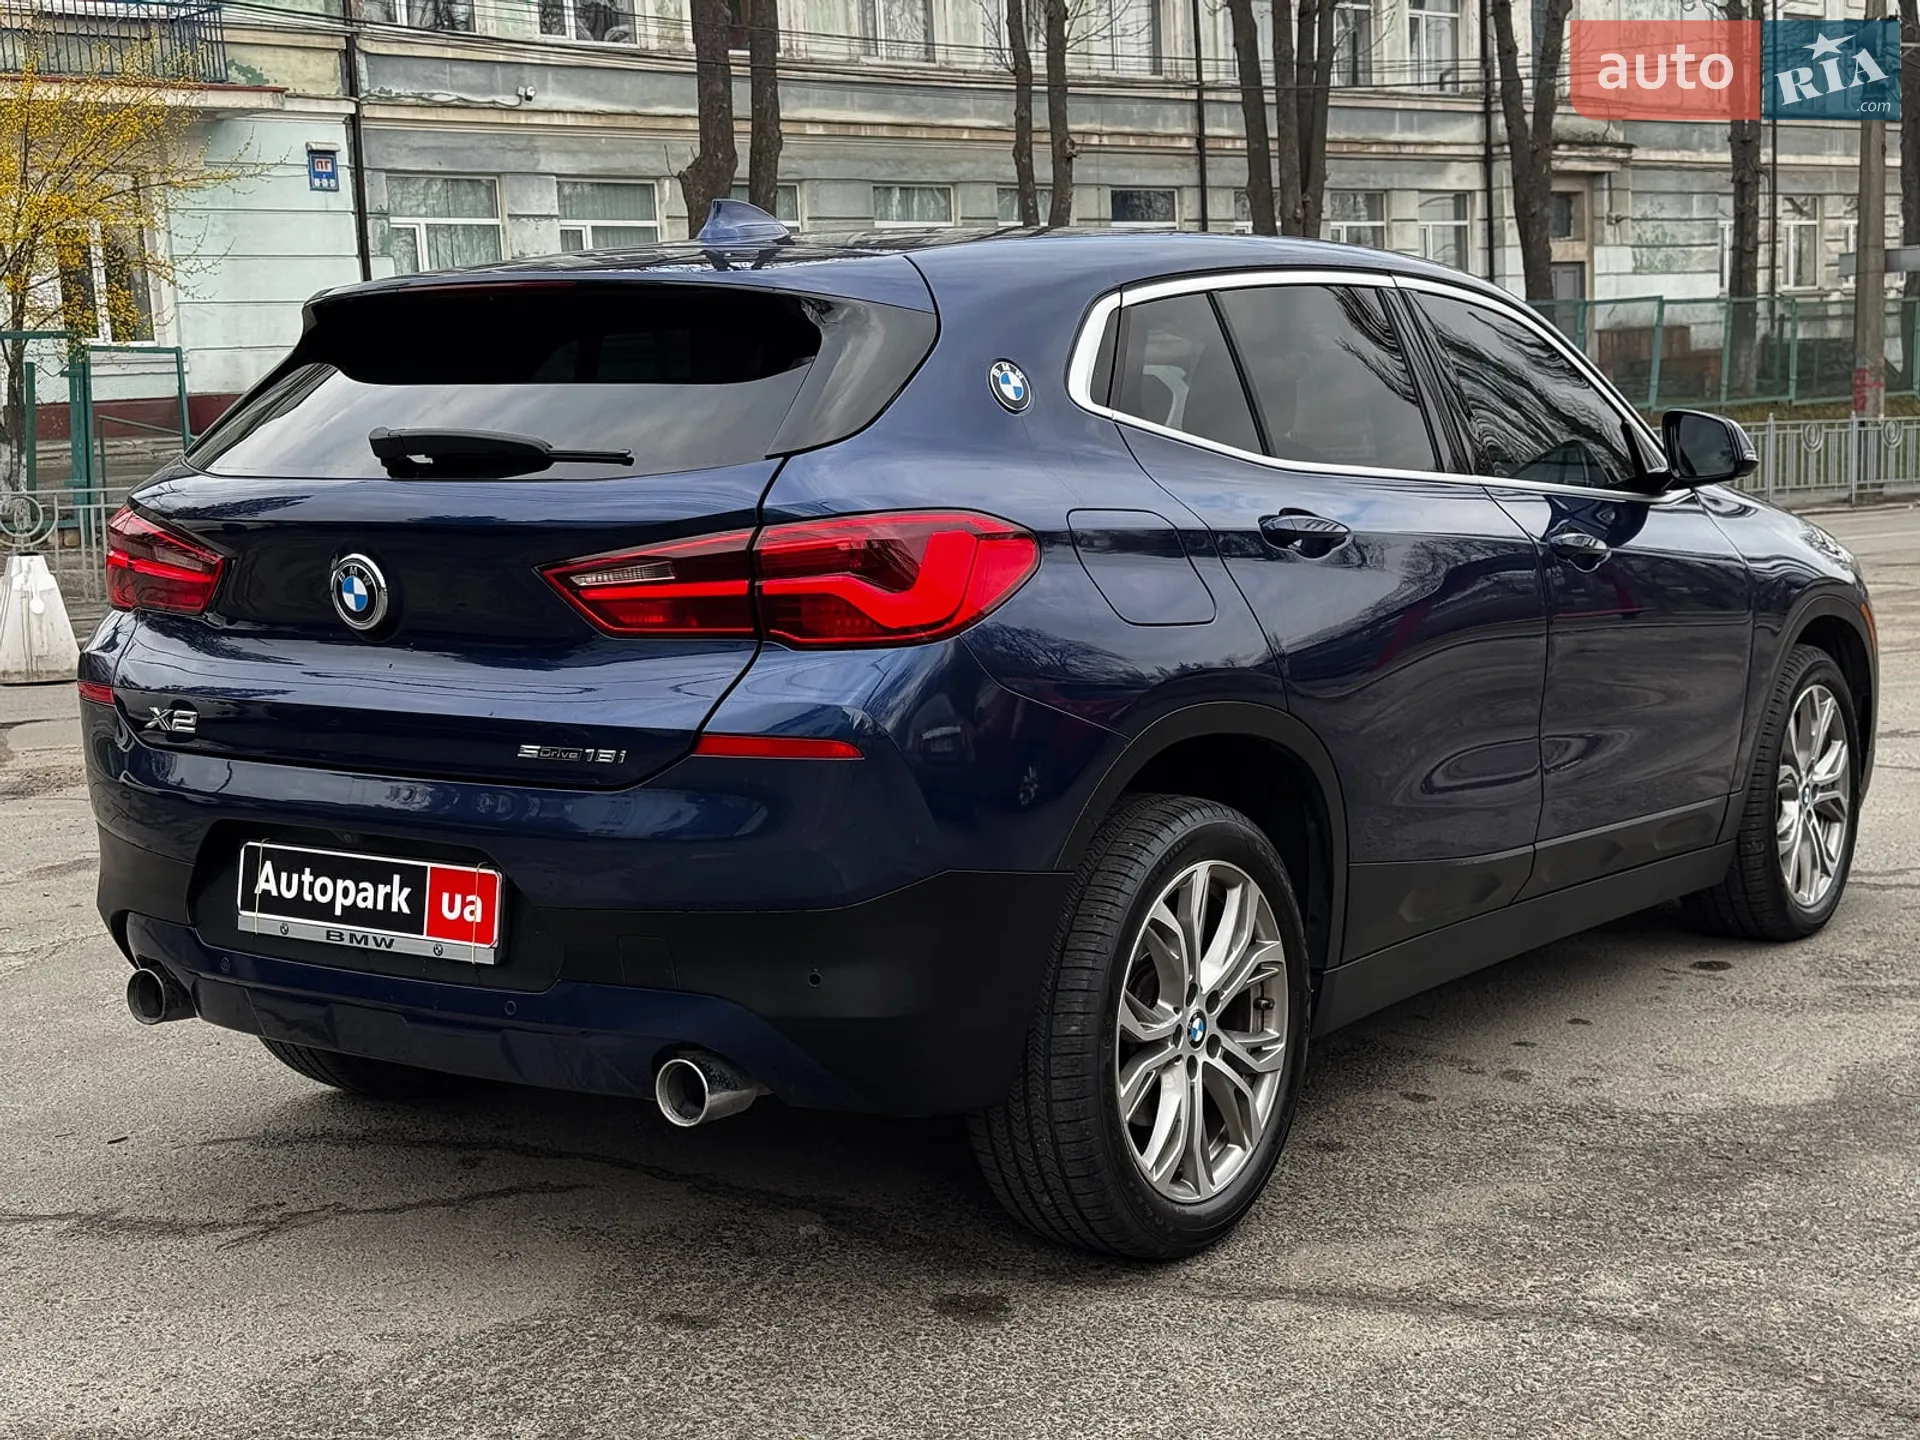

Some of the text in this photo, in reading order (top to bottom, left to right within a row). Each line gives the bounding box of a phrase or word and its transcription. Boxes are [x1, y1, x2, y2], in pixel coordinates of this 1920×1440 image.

[992, 362, 1024, 379] BMW
[338, 566, 372, 586] BMW
[144, 706, 198, 734] X2
[254, 860, 483, 923] Autopark ua
[326, 929, 395, 949] BMW
